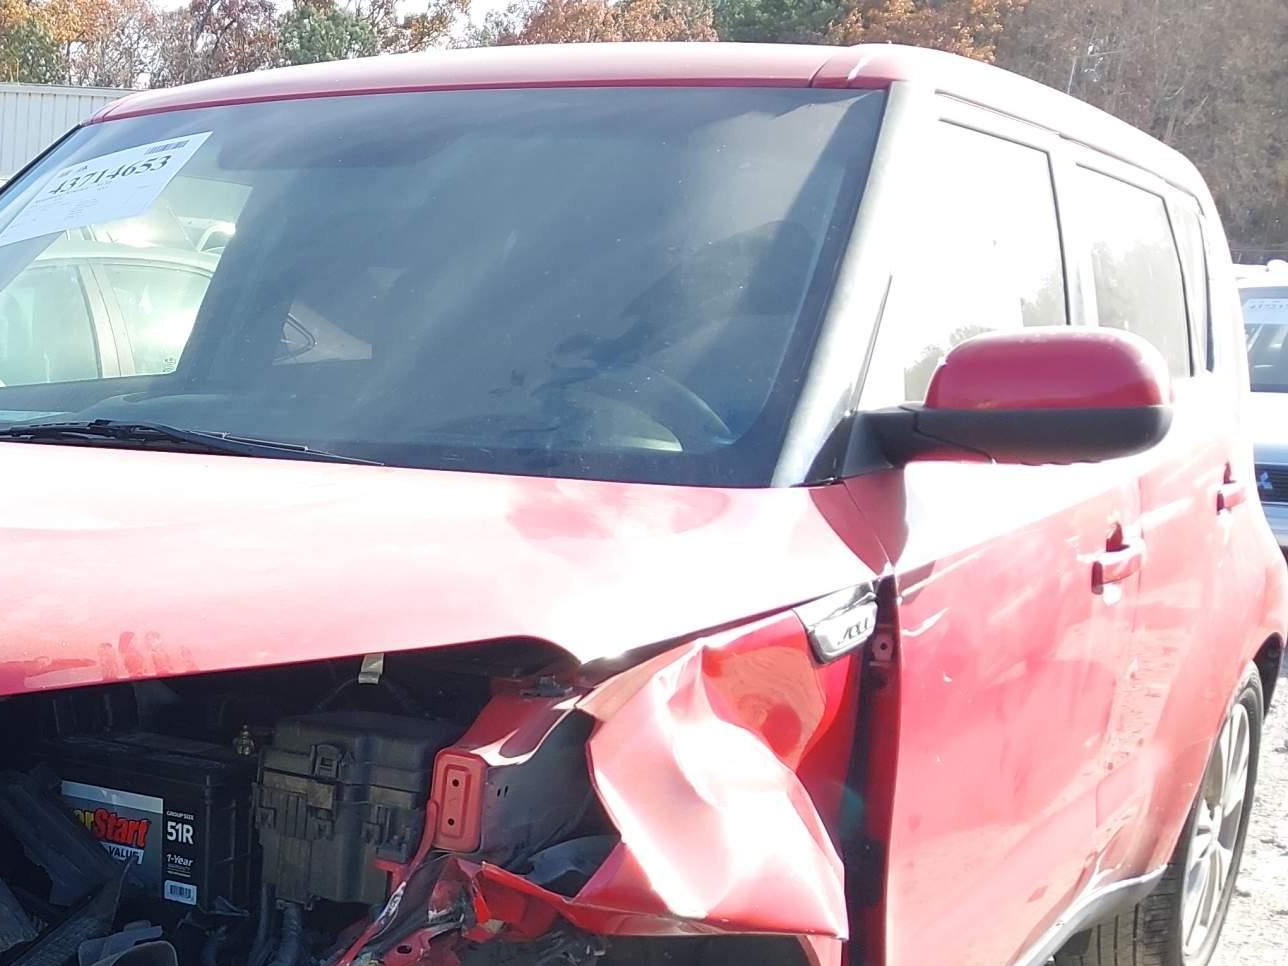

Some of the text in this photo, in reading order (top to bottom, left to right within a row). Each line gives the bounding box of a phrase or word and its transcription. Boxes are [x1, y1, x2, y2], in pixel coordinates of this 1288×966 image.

[49, 154, 173, 195] 43714653
[166, 821, 194, 845] 51R
[166, 854, 193, 867] 1-Year
